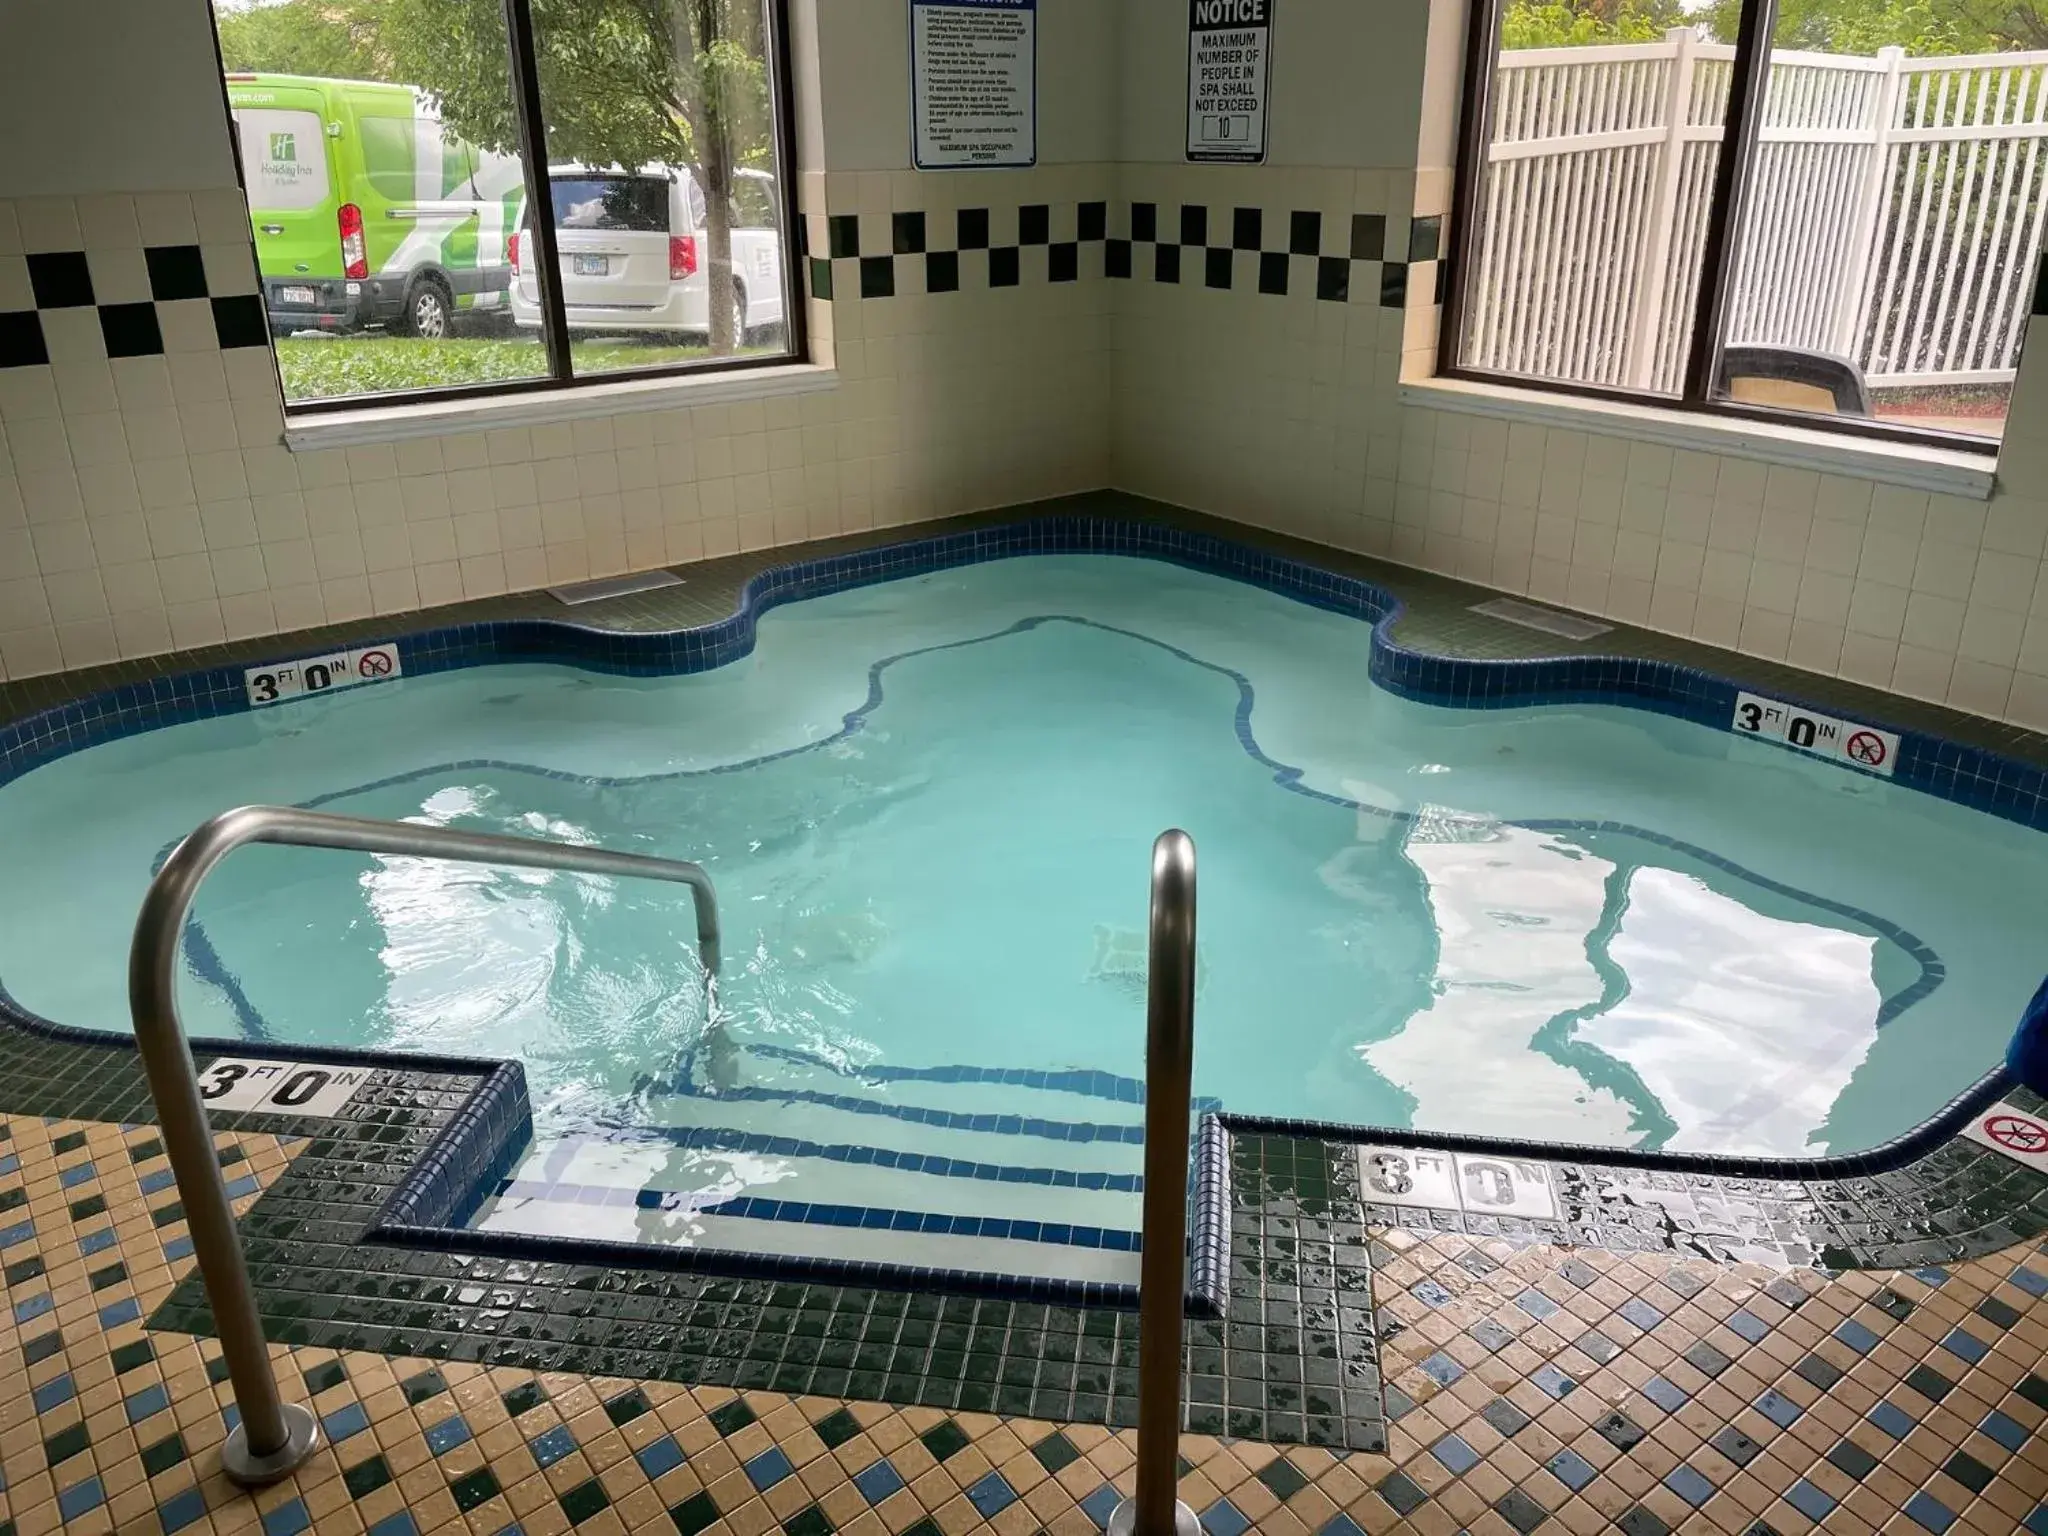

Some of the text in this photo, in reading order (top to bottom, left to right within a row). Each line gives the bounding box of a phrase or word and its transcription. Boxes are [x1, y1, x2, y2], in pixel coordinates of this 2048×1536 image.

[1196, 0, 1264, 24] NOTICE
[1202, 33, 1256, 48] MAXIMUM
[1197, 49, 1260, 64] NUMBER OF
[1201, 66, 1254, 79] PEOPLE IN
[1200, 83, 1254, 96] SPA SHALL
[1195, 98, 1258, 111] NOT EXCEED
[1219, 117, 1230, 138] 10
[253, 660, 346, 701] 3 FT 0 IN
[1737, 703, 1836, 747] 3 FT 0 IN
[201, 1064, 363, 1106] 3 FT 0 IN
[1368, 1153, 1547, 1206] 3 FT 0 IN
